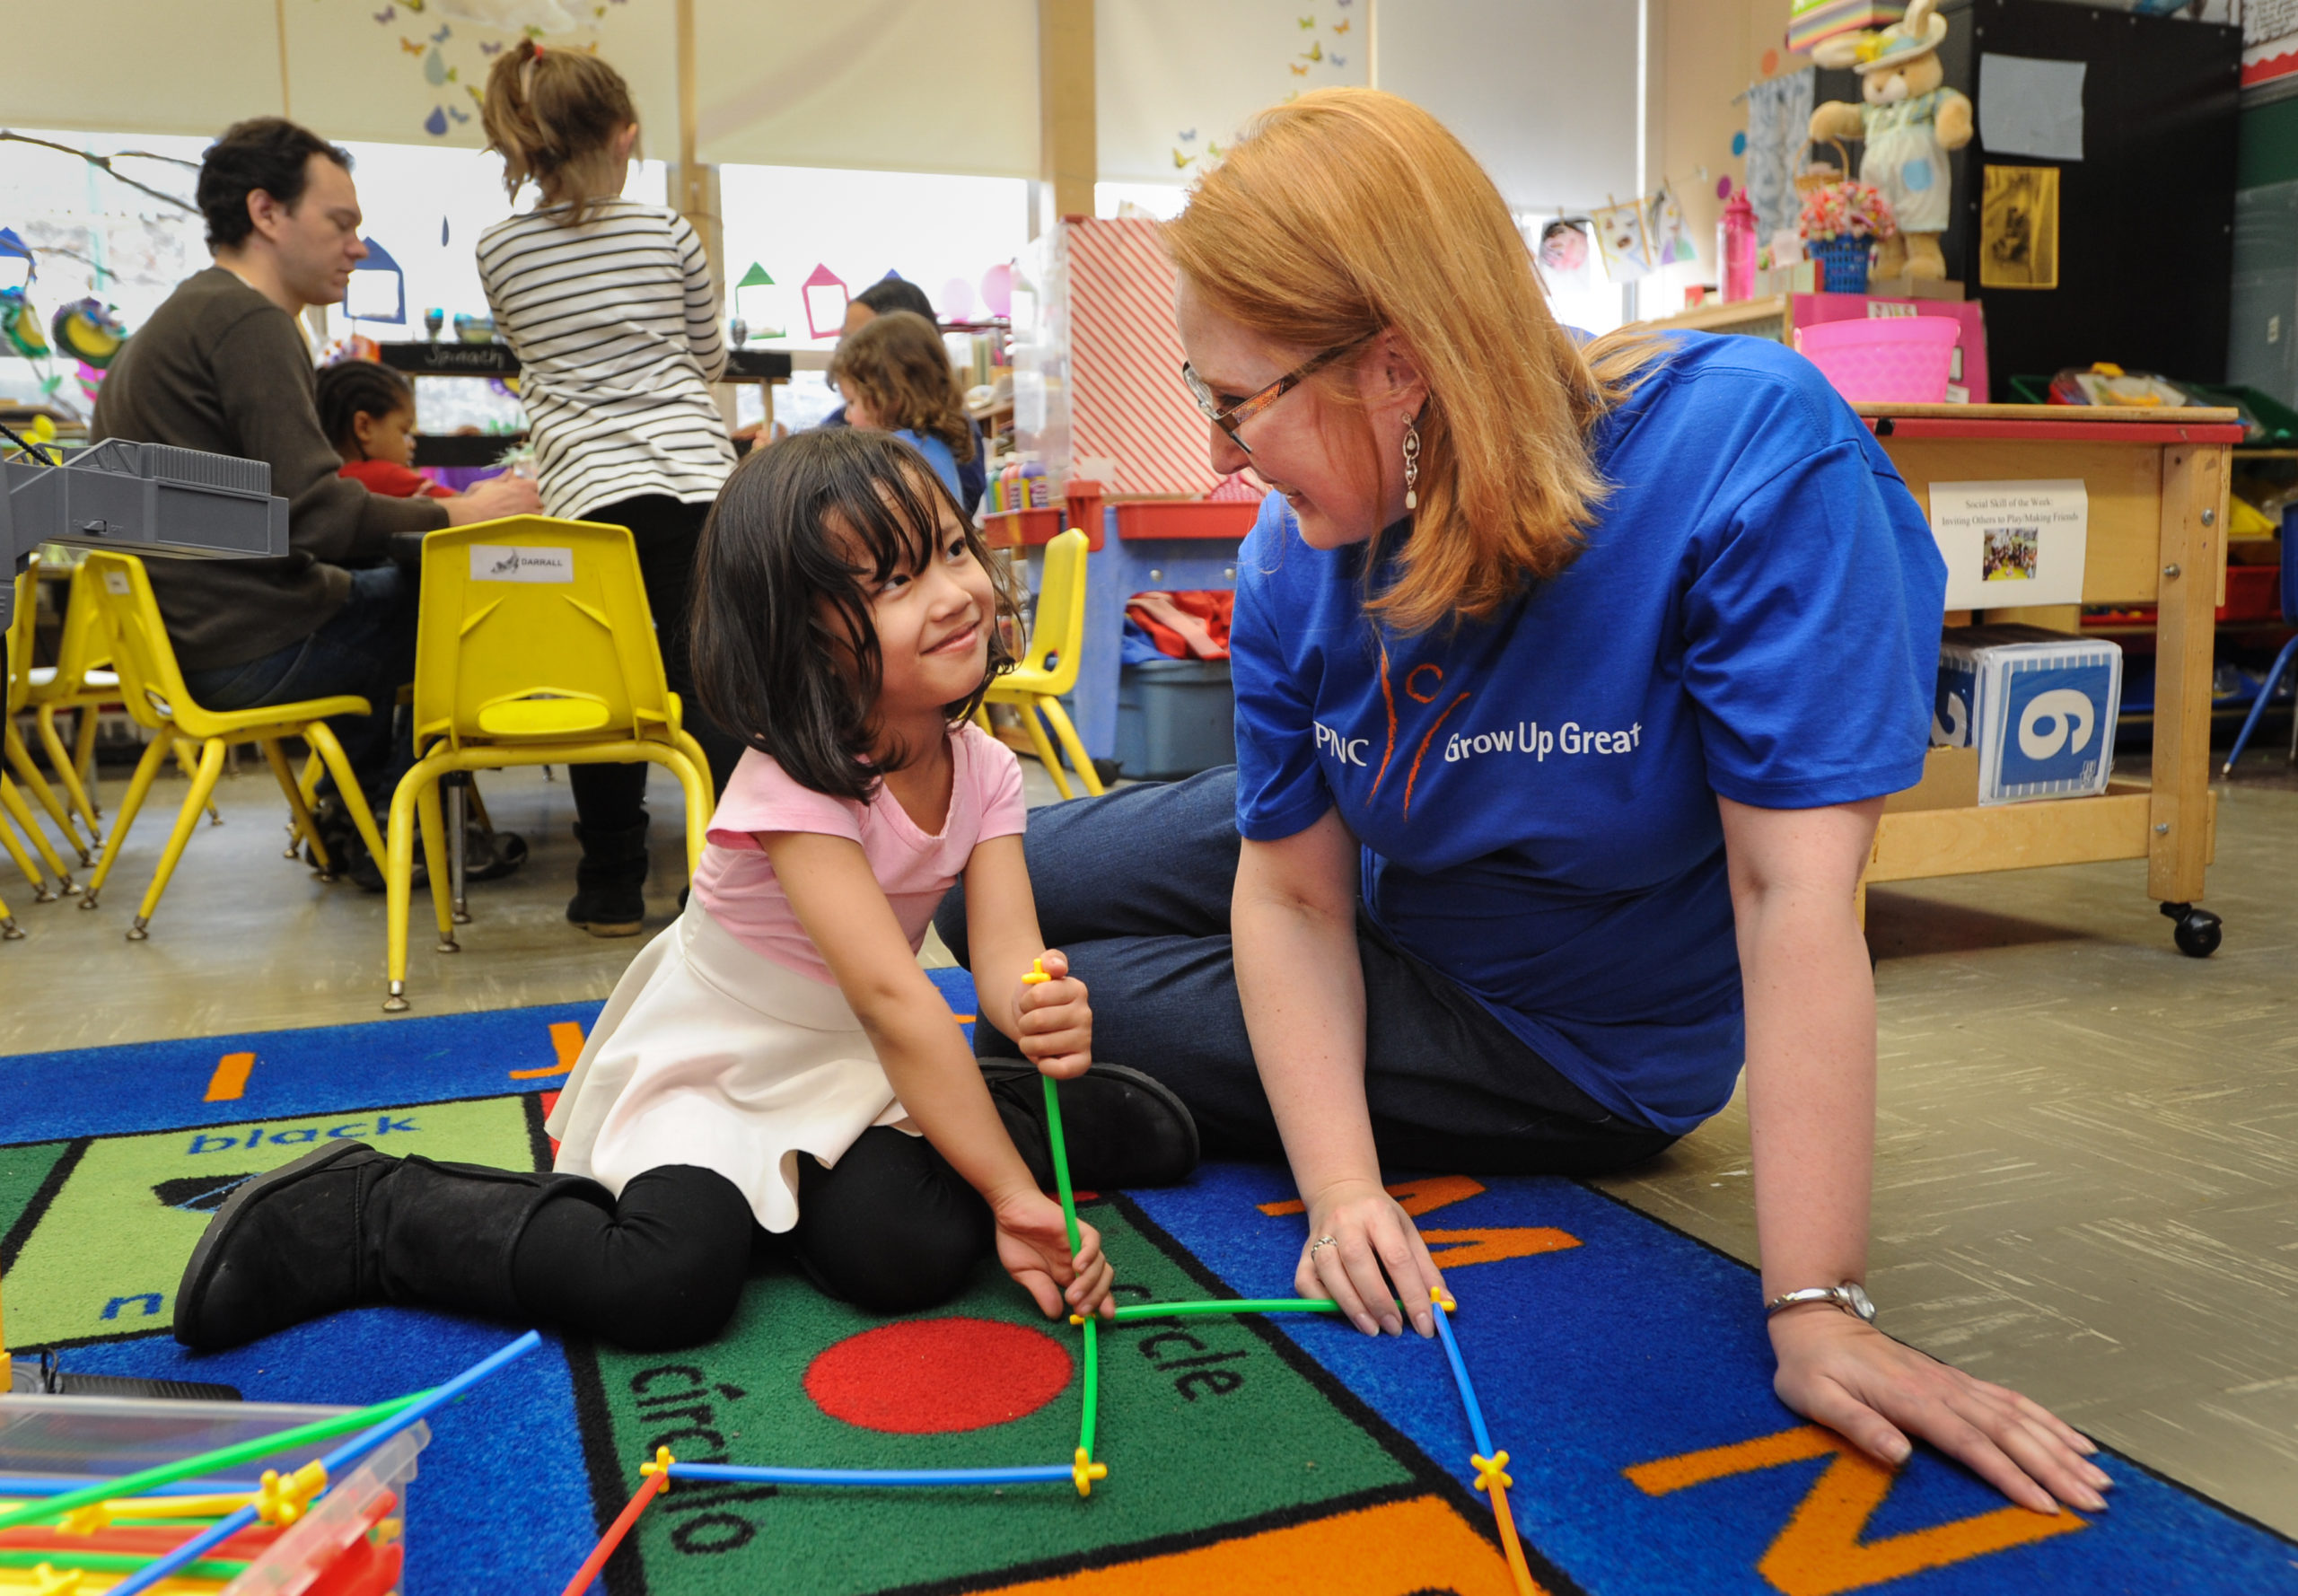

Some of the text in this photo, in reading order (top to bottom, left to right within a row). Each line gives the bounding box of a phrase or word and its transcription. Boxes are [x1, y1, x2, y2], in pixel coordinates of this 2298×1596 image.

[1965, 499, 1988, 509] Social
[1990, 498, 2007, 508] Skill
[2008, 498, 2016, 507] of
[2018, 497, 2030, 507] the
[1942, 515, 1970, 527] Inviting
[1972, 514, 1996, 525] Others
[1997, 515, 2005, 524] to
[2053, 511, 2079, 522] Friends
[521, 557, 564, 567] DARRALL
[1313, 720, 1643, 767] PNC Grow Up Great
[187, 1116, 422, 1155] black
